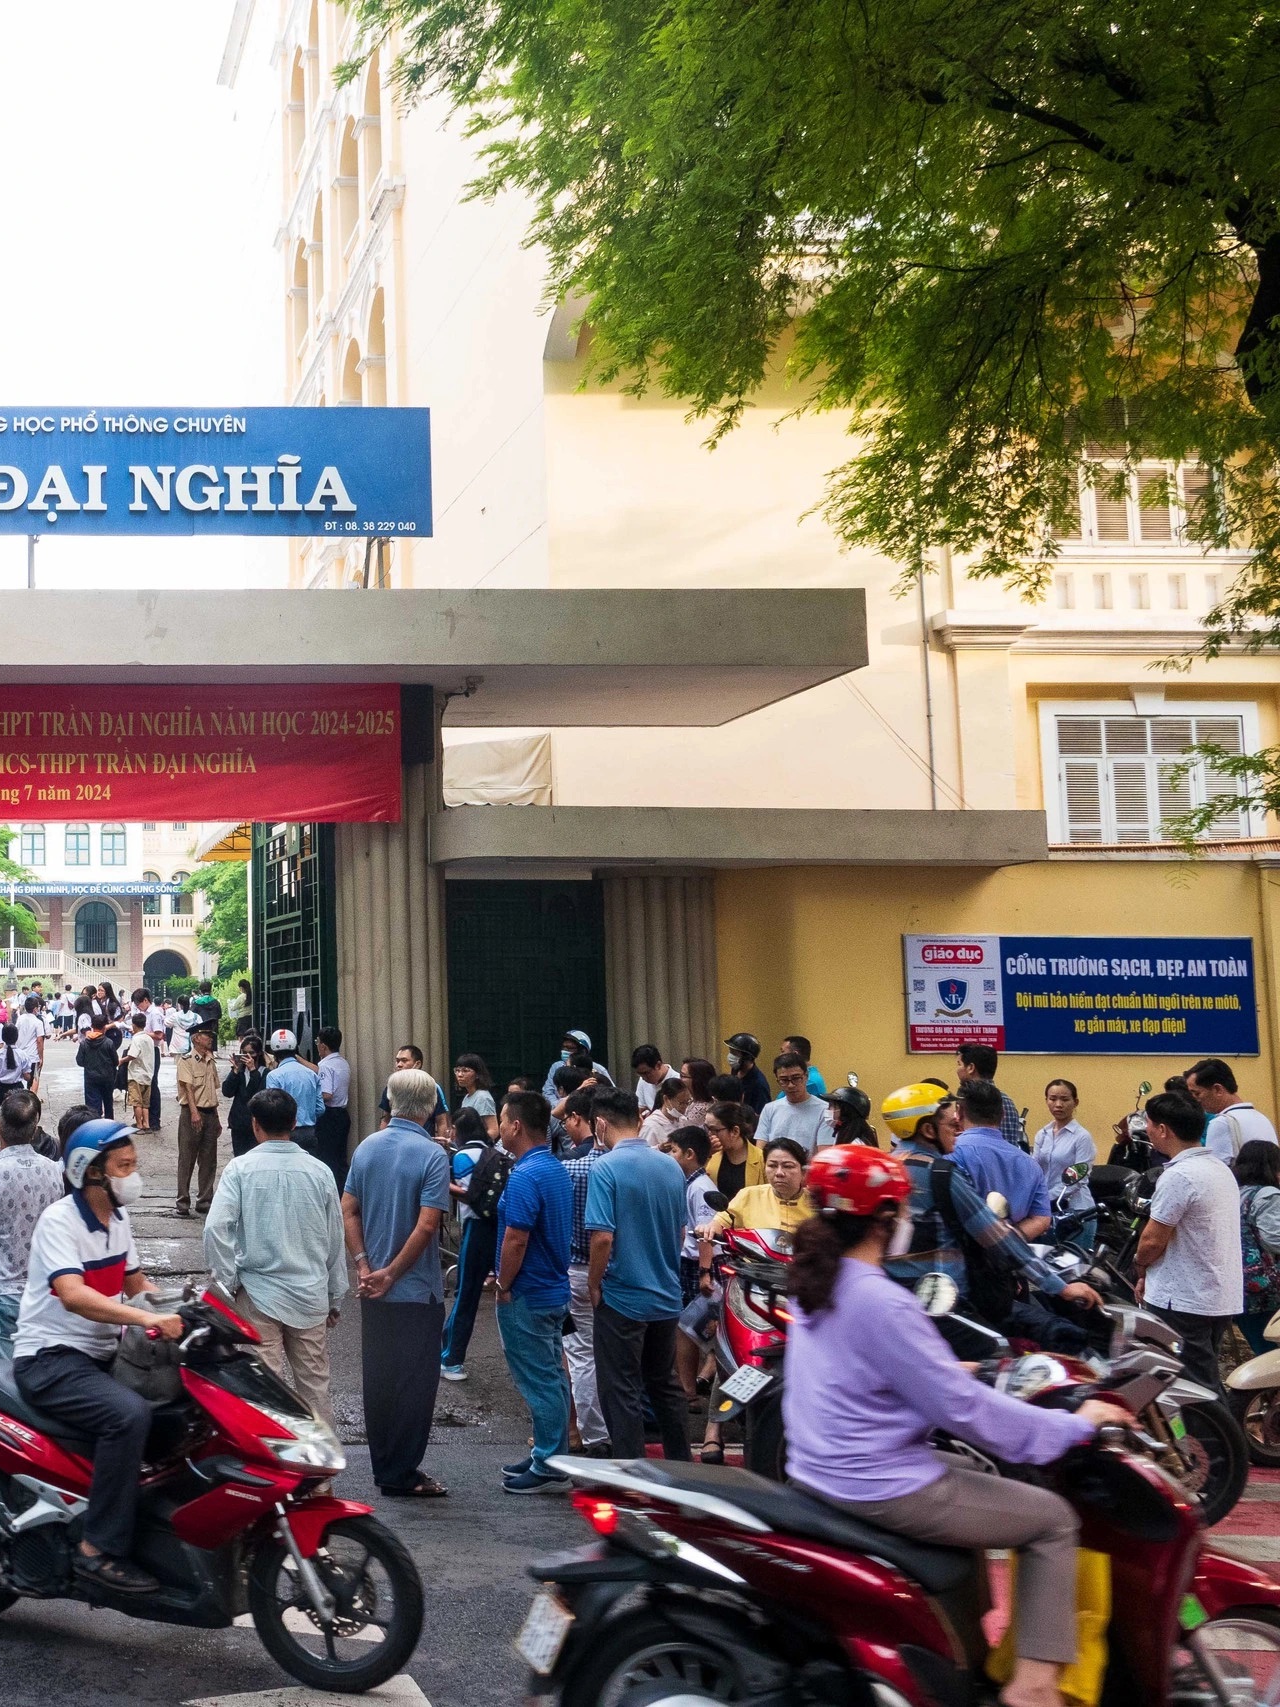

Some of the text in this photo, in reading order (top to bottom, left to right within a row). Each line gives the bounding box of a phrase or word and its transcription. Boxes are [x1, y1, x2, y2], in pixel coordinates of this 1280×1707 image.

[13, 417, 55, 436] HỌC
[61, 410, 99, 432] PHỔ
[103, 414, 169, 433] THÔNG
[173, 414, 246, 433] CHUYÊN
[128, 454, 357, 512] NGHĨA
[324, 522, 337, 530] ĐT
[363, 522, 375, 531] 38
[377, 522, 395, 531] 229
[398, 522, 416, 531] 040
[39, 704, 93, 736] TRẦN
[99, 711, 134, 743] ĐẠI
[140, 705, 204, 736] NGHĨA
[210, 705, 255, 736] NĂM
[262, 711, 305, 742] HỌC
[310, 710, 395, 735] 2024-2025
[93, 746, 146, 774] TRẦN
[153, 753, 187, 780] ĐẠI
[193, 747, 257, 774] NGHĨA
[24, 784, 33, 800] 7
[38, 785, 71, 800] năm
[75, 784, 111, 800] 2024
[71, 885, 88, 895] HỌC
[102, 883, 125, 893] CÙNG
[126, 885, 154, 893] CHUNG
[924, 946, 981, 962] giáo dục
[1006, 953, 1248, 980] CỔNG TRƯỜNG SẠCH, ĐẸP, AN TOÀN
[1016, 991, 1032, 1011] Đội
[1033, 992, 1049, 1008] mũ
[1050, 990, 1068, 1008] bảo
[1069, 990, 1094, 1009] hiểm
[1095, 993, 1111, 1012] đạt
[1112, 991, 1141, 1009] chuẩn
[1142, 994, 1158, 1009] khi
[1159, 992, 1180, 1011] ngồi
[1181, 994, 1201, 1009] trên
[1202, 996, 1214, 1009] xe
[1074, 1015, 1187, 1037] xe gắn máy, xe đạp điện!
